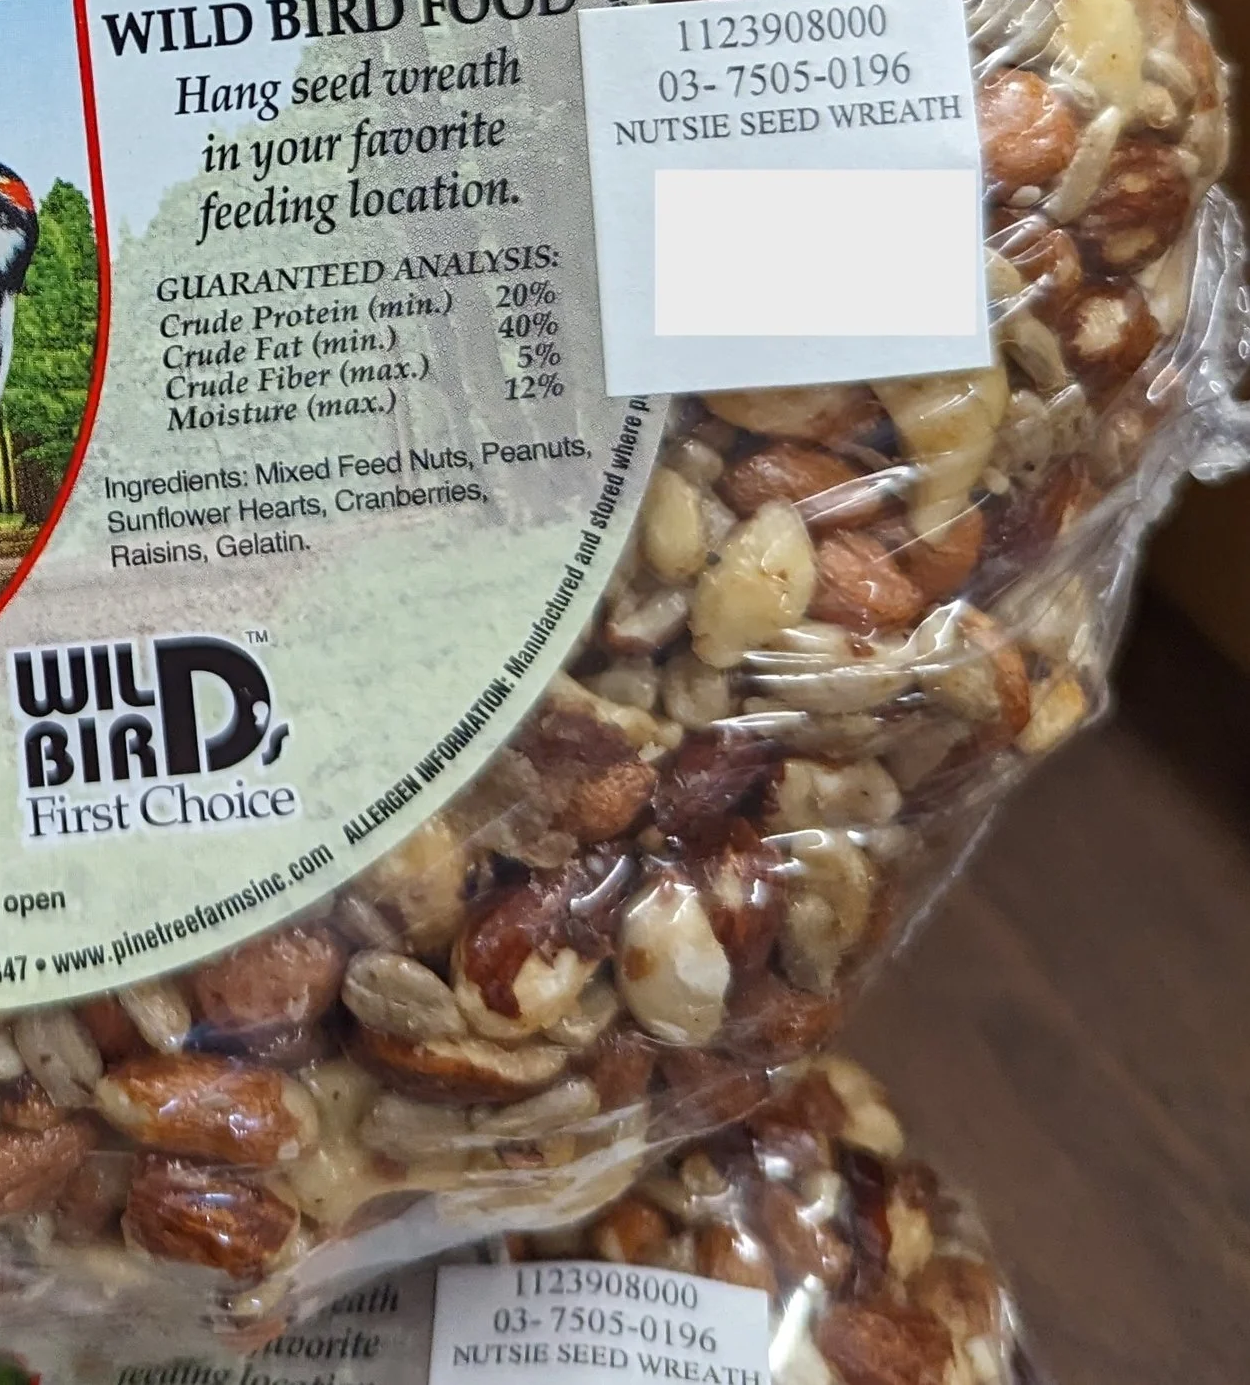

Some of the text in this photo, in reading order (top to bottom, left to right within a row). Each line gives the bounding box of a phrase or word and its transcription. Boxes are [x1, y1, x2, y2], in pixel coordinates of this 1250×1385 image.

[102, 3, 254, 57] WILD
[677, 3, 888, 53] 1123908000
[175, 47, 521, 122] Hang seed wreath
[657, 52, 911, 103] 03- 7505-0196
[201, 112, 506, 181] in your favorite
[613, 94, 963, 146] NUTSIE SEED WREATH
[196, 171, 520, 245] feeding location.
[155, 244, 560, 302] GUARANTEED ANALYSIS:
[159, 282, 557, 339] Crude Protein (min.) 20%
[162, 311, 560, 371] Crude Fat (min.) 40%
[165, 341, 561, 401] Crude Fiber (max.) 5%
[166, 373, 566, 432] Moisture (max.) 12%
[104, 437, 593, 504] Ingredients: Mixed Feed Nuts, Peanuts,
[107, 481, 489, 535] Sunflower Hearts, Cranberries,
[110, 531, 312, 570] Raisins, Gelatin.
[245, 630, 269, 644] TM
[341, 414, 642, 846] ALLERGEN INFORMATION: Manufactured and stored where
[26, 780, 296, 837] First Choice
[3, 889, 67, 916] open
[51, 840, 335, 976] www.pinetreefarmsinc.com
[515, 1268, 698, 1310] 1123908000
[494, 1306, 717, 1352] 03- 7505-0196
[452, 1343, 760, 1385] NUTSIE SEED WREATH
